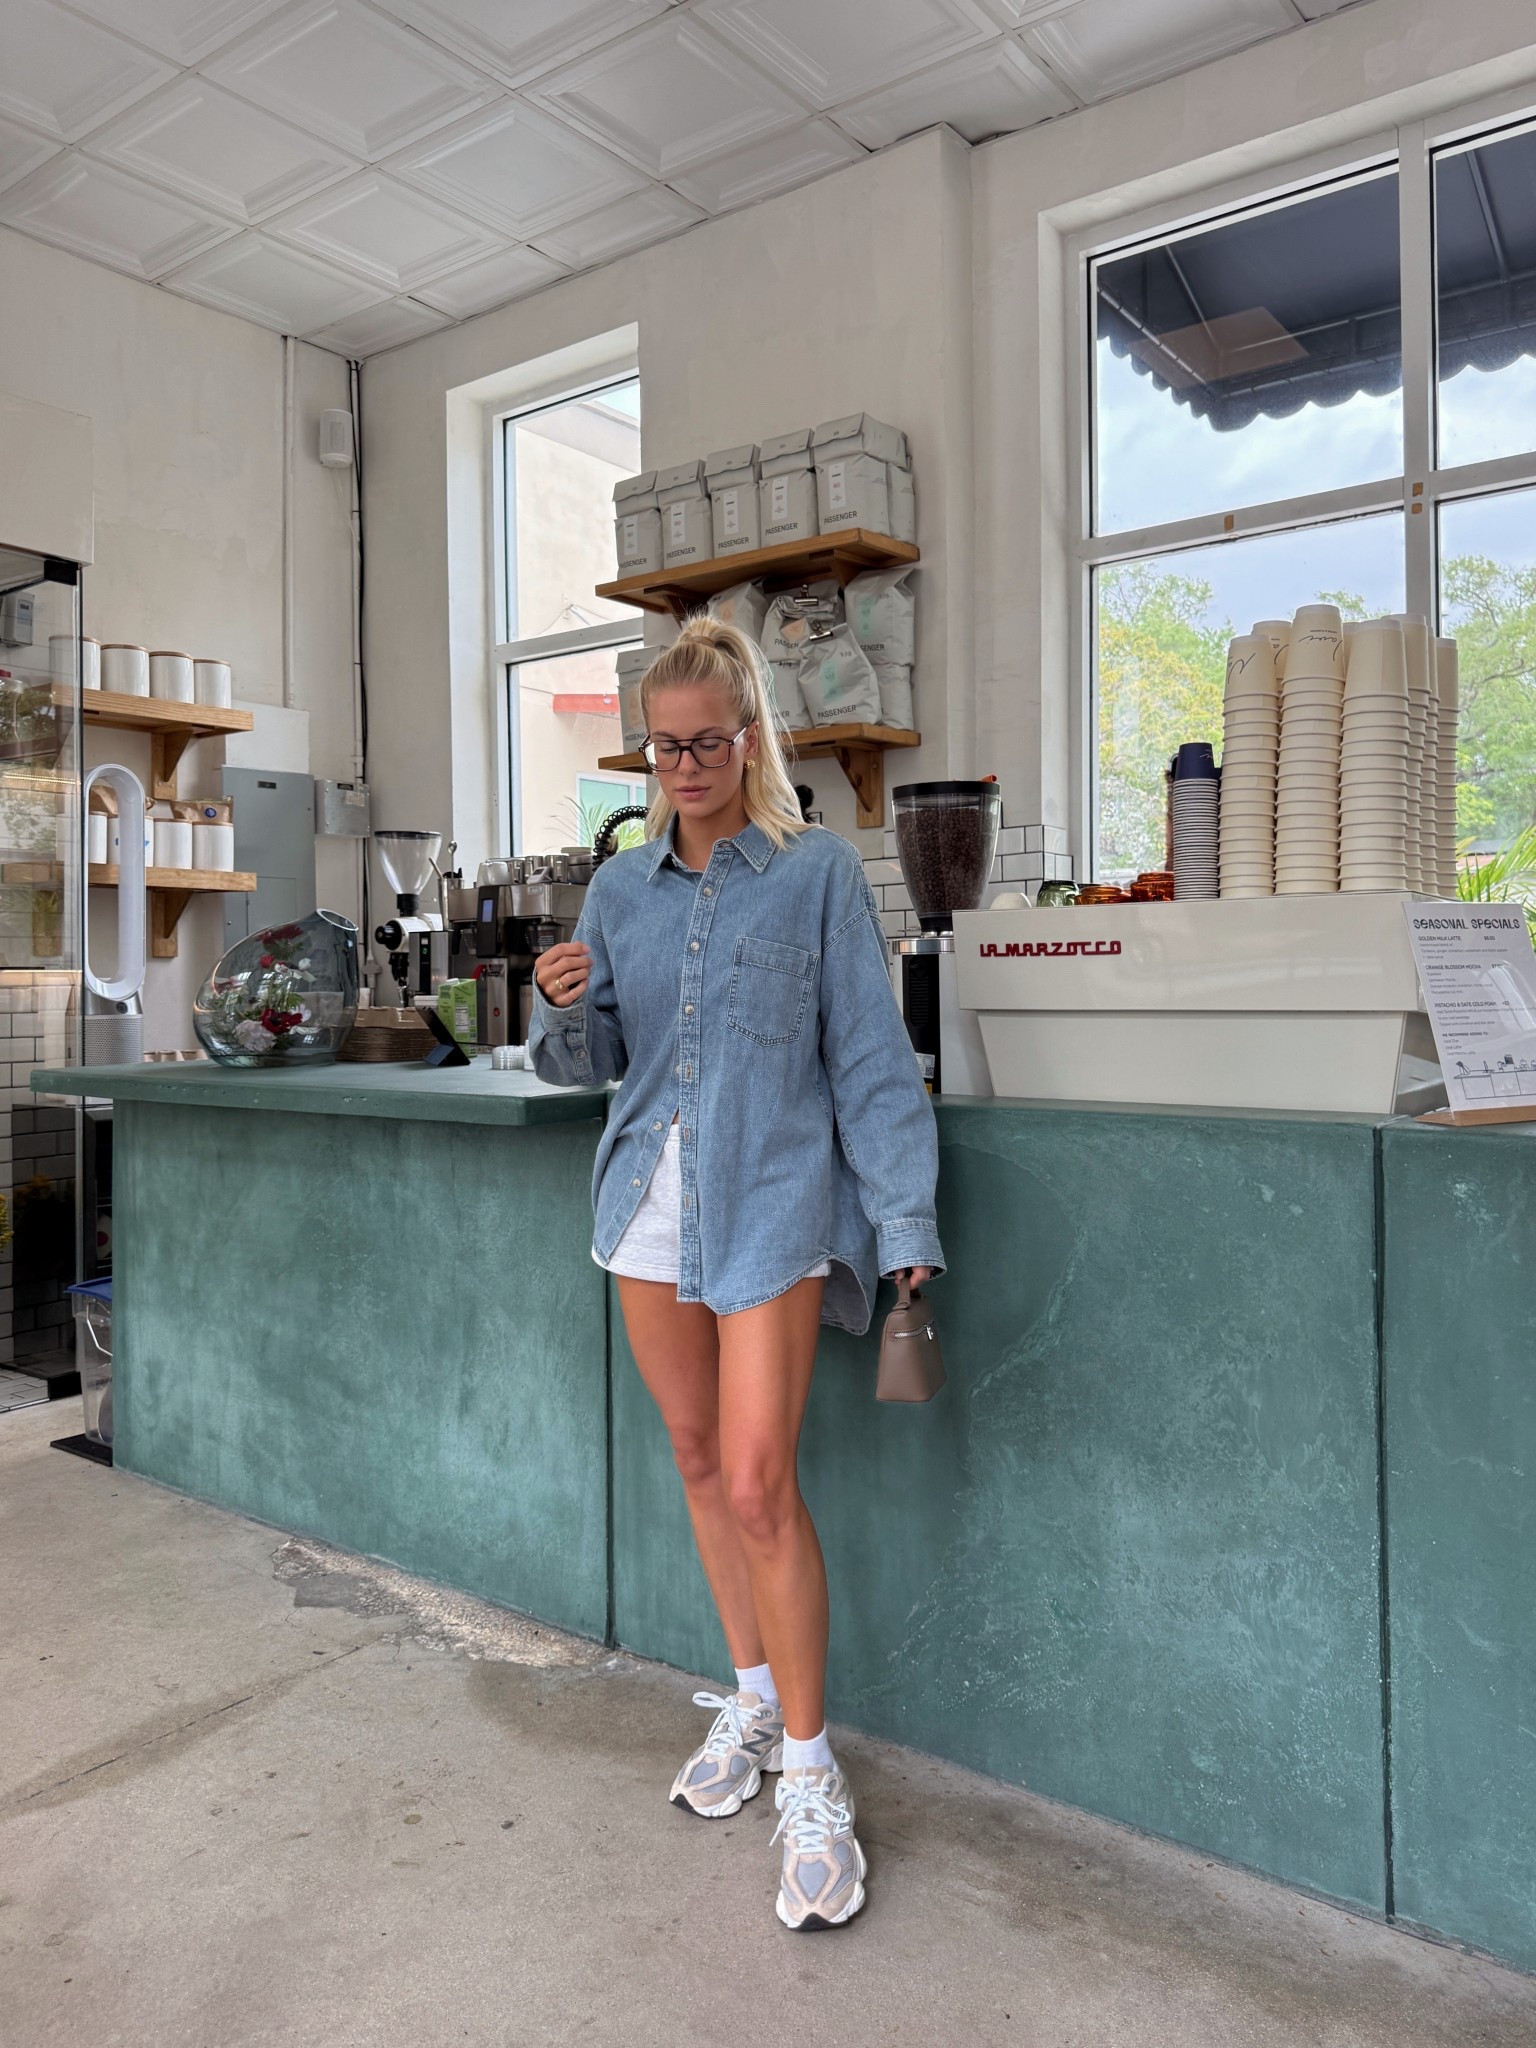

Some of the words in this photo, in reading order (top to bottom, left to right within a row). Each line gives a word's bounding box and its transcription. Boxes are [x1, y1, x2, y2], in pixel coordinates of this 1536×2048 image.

[823, 510, 859, 525] PASSENGER
[764, 522, 799, 536] PASSENGER
[717, 536, 750, 550] PASSENGER
[666, 546, 697, 560] PASSENGER
[774, 638, 799, 649] PASSEN
[859, 643, 885, 652] SENGER
[817, 704, 857, 719] PASSENGER
[1005, 940, 1122, 957] MARZOCCO
